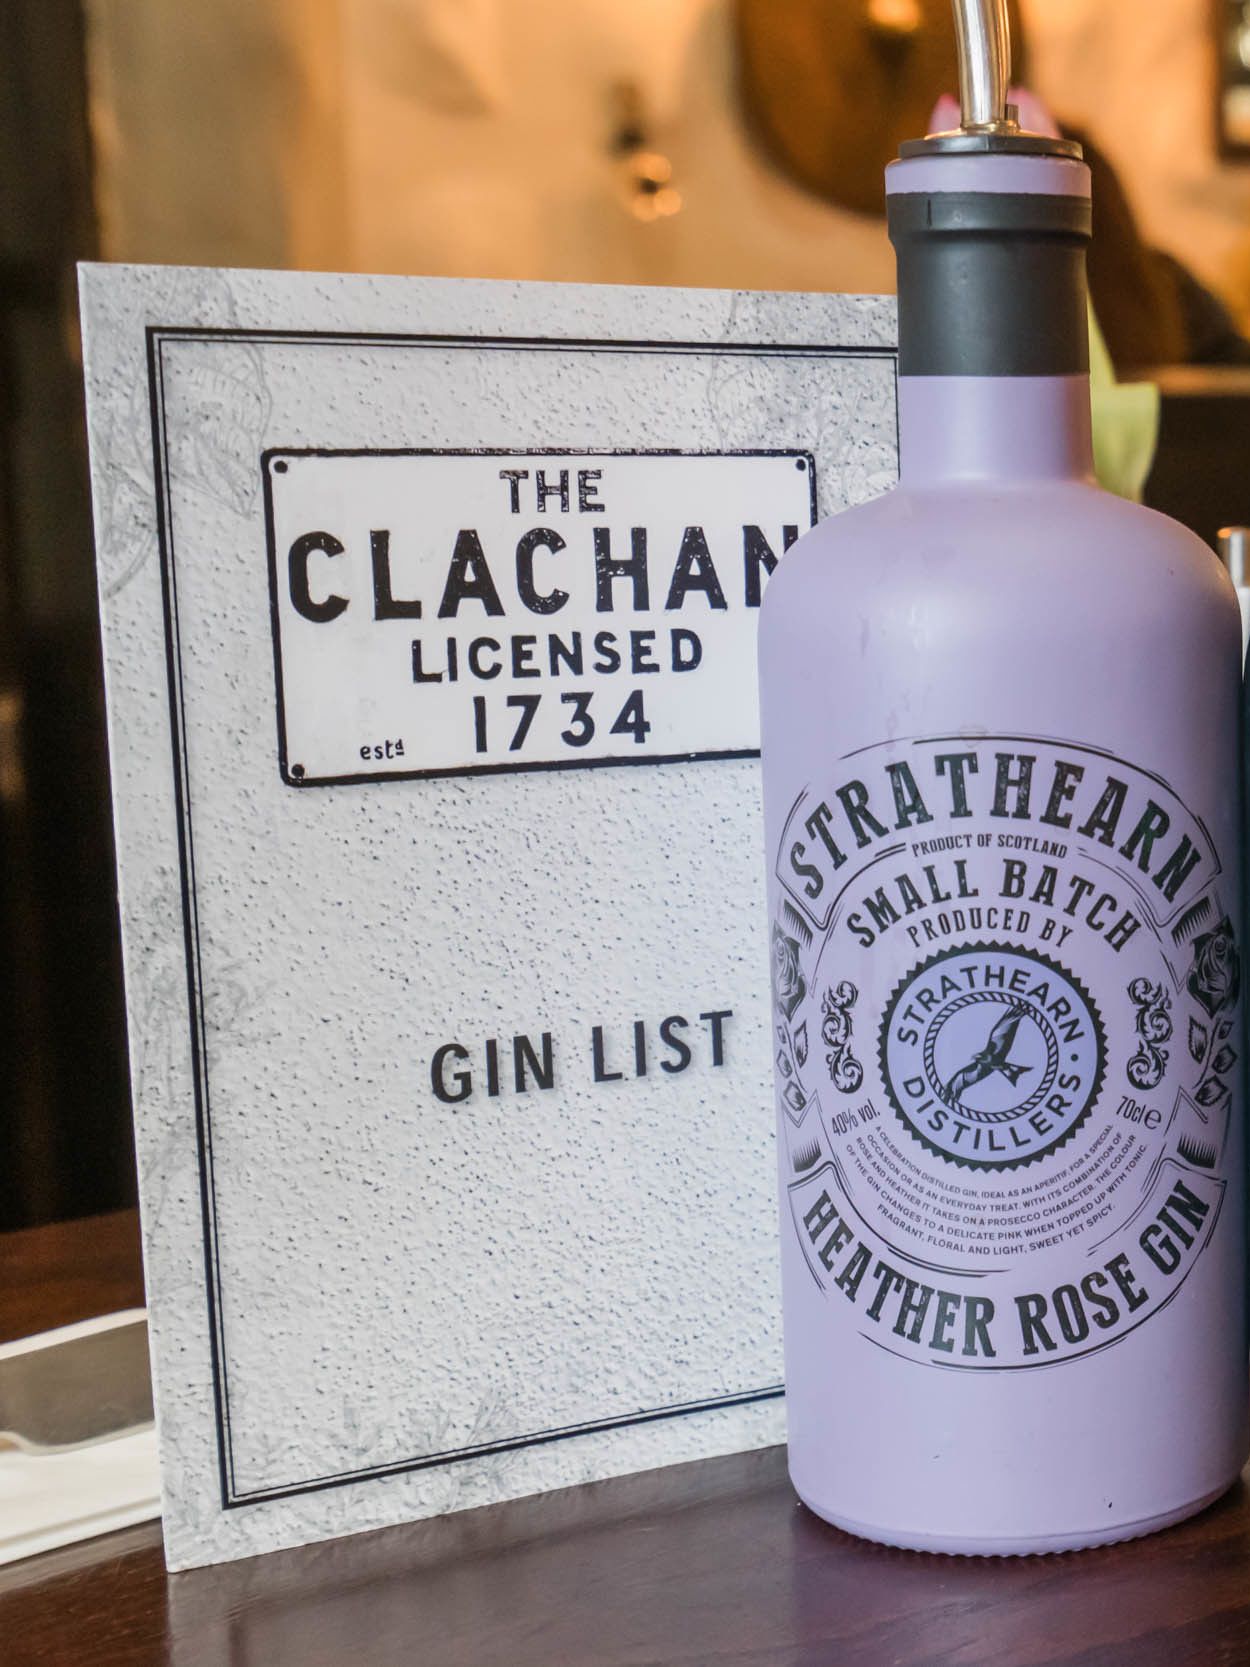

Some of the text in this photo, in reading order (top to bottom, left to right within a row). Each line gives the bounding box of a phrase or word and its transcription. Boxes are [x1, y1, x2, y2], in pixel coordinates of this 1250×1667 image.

[500, 470, 606, 513] THE
[411, 629, 703, 683] LICENSED
[474, 689, 651, 752] 1734
[790, 752, 1202, 902] STRATHEARN
[912, 834, 1068, 858] PRODUCT OF SCOTLAND
[847, 858, 1142, 952] SMALL BATCH
[906, 908, 1073, 947] PRODUCED BY
[897, 965, 1084, 1046] STRATHEARN
[431, 1010, 733, 1104] GIN LIST
[832, 1107, 859, 1136] 40%
[903, 1073, 1080, 1151] DISTILLERS
[846, 1144, 856, 1157] OF
[854, 1158, 867, 1177] THE
[866, 1175, 881, 1192] GIN
[880, 1190, 922, 1223] CHANGES
[923, 1219, 936, 1229] TO
[946, 1226, 995, 1241] DELICATE
[997, 1231, 1022, 1240] PINK
[1024, 1222, 1055, 1237] WHEN
[1057, 1202, 1094, 1227] TOPPED
[1093, 1192, 1106, 1205] UP
[1105, 1173, 1127, 1195] WITH
[856, 1137, 873, 1161] ROSE
[871, 1161, 886, 1179] AND
[885, 1177, 925, 1206] HEATHER
[922, 1202, 931, 1211] IT
[932, 1207, 960, 1222] TAKES
[962, 1216, 977, 1225] ON
[988, 1212, 1041, 1226] PROSECCO
[1095, 1168, 1112, 1185] THE
[1110, 1134, 1136, 1170] COLOUR
[867, 1134, 901, 1176] OCCASION
[901, 1173, 913, 1185] OR
[913, 1181, 925, 1194] AS
[926, 1189, 938, 1200] AN
[939, 1195, 987, 1212] EVERYDAY
[1023, 1195, 1046, 1209] WITH
[1047, 1188, 1062, 1201] ITS
[1062, 1145, 1114, 1193] COMBINATION
[1113, 1132, 1122, 1146] OF
[879, 1131, 922, 1176] CELEBRATION
[921, 1173, 961, 1194] DISTILLED
[981, 1190, 1006, 1199] IDEAL
[1008, 1189, 1020, 1197] AS
[1021, 1186, 1033, 1196] AN
[1070, 1157, 1085, 1172] FOR
[1089, 1124, 1114, 1155] SPECIAL
[803, 1180, 1210, 1358] HEATHER ROSE GIN
[928, 1235, 965, 1253] FLORAL
[968, 1245, 990, 1255] AND
[1029, 1233, 1065, 1251] SWEET
[1066, 1223, 1085, 1238] YET
